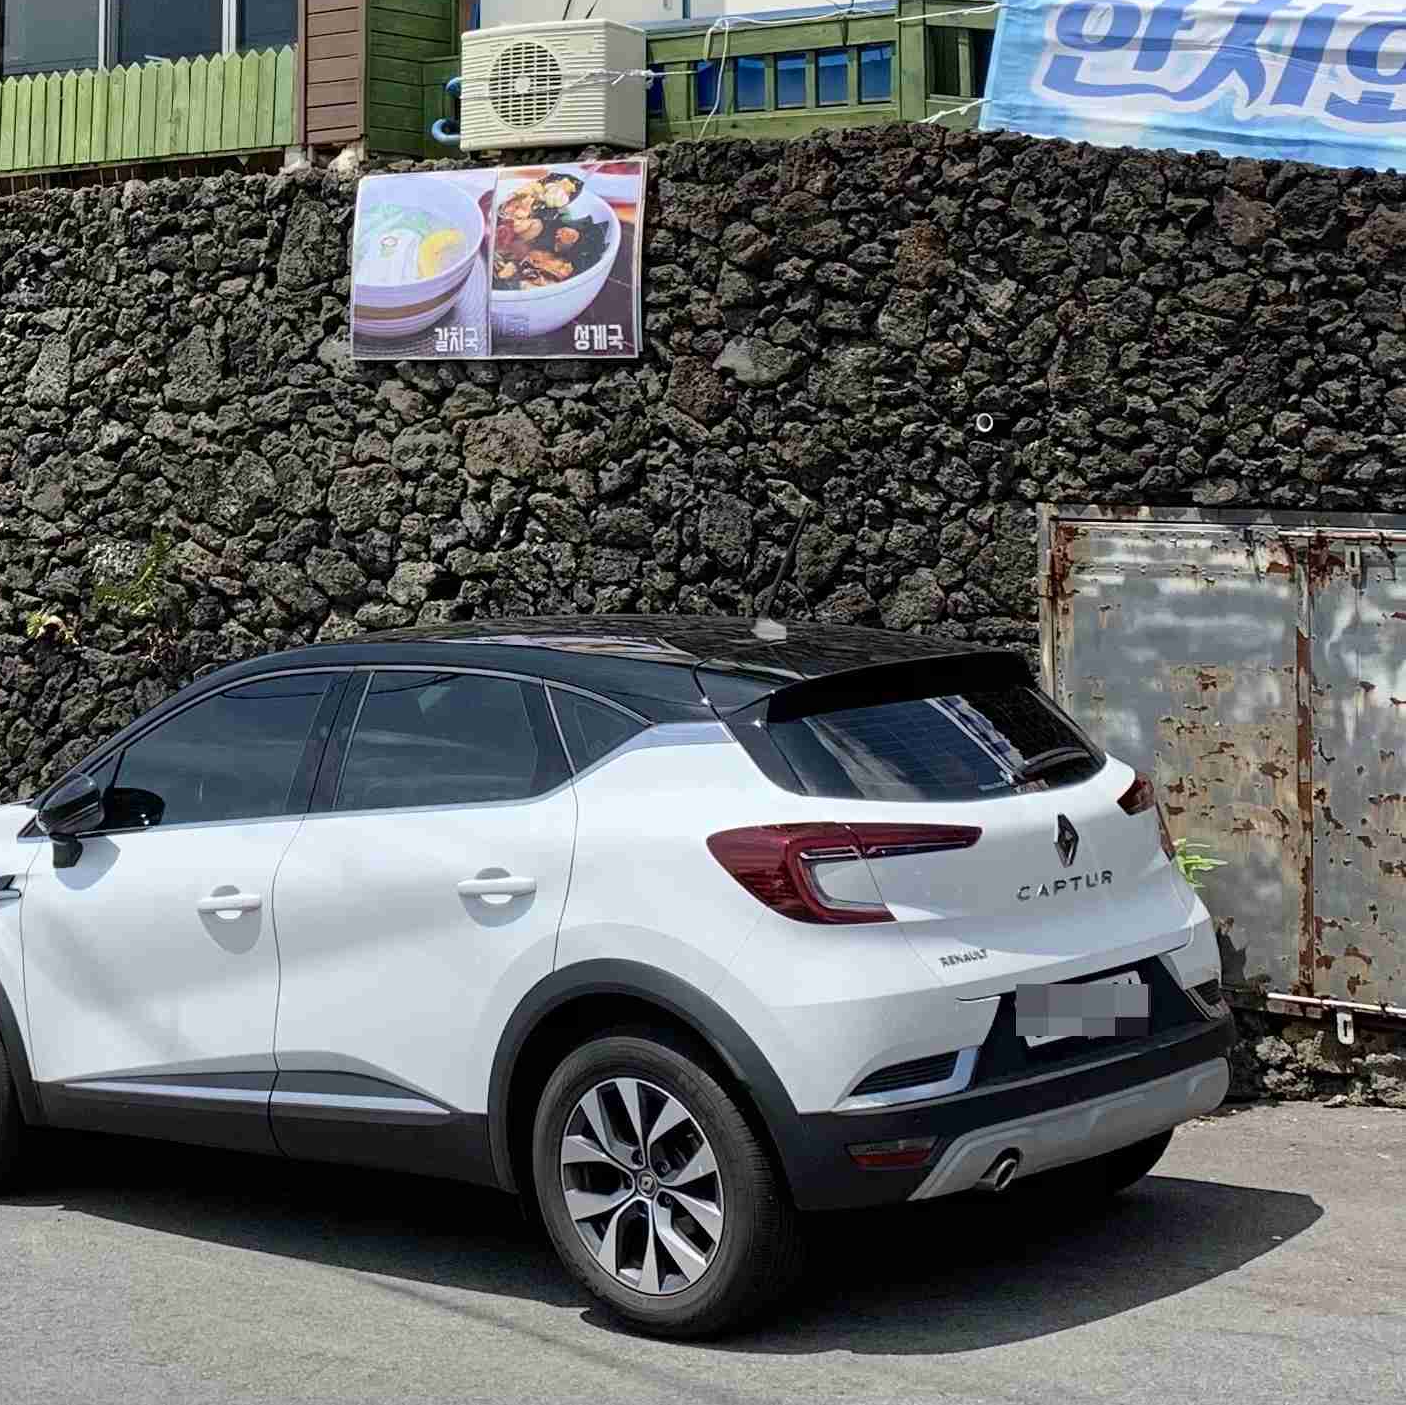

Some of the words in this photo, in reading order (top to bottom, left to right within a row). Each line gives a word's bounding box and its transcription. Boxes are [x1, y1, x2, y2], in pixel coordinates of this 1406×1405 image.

[434, 326, 481, 352] 갈치국
[573, 323, 625, 351] 성게국
[1016, 870, 1114, 901] CAPTUR
[937, 948, 988, 968] RENAULT
